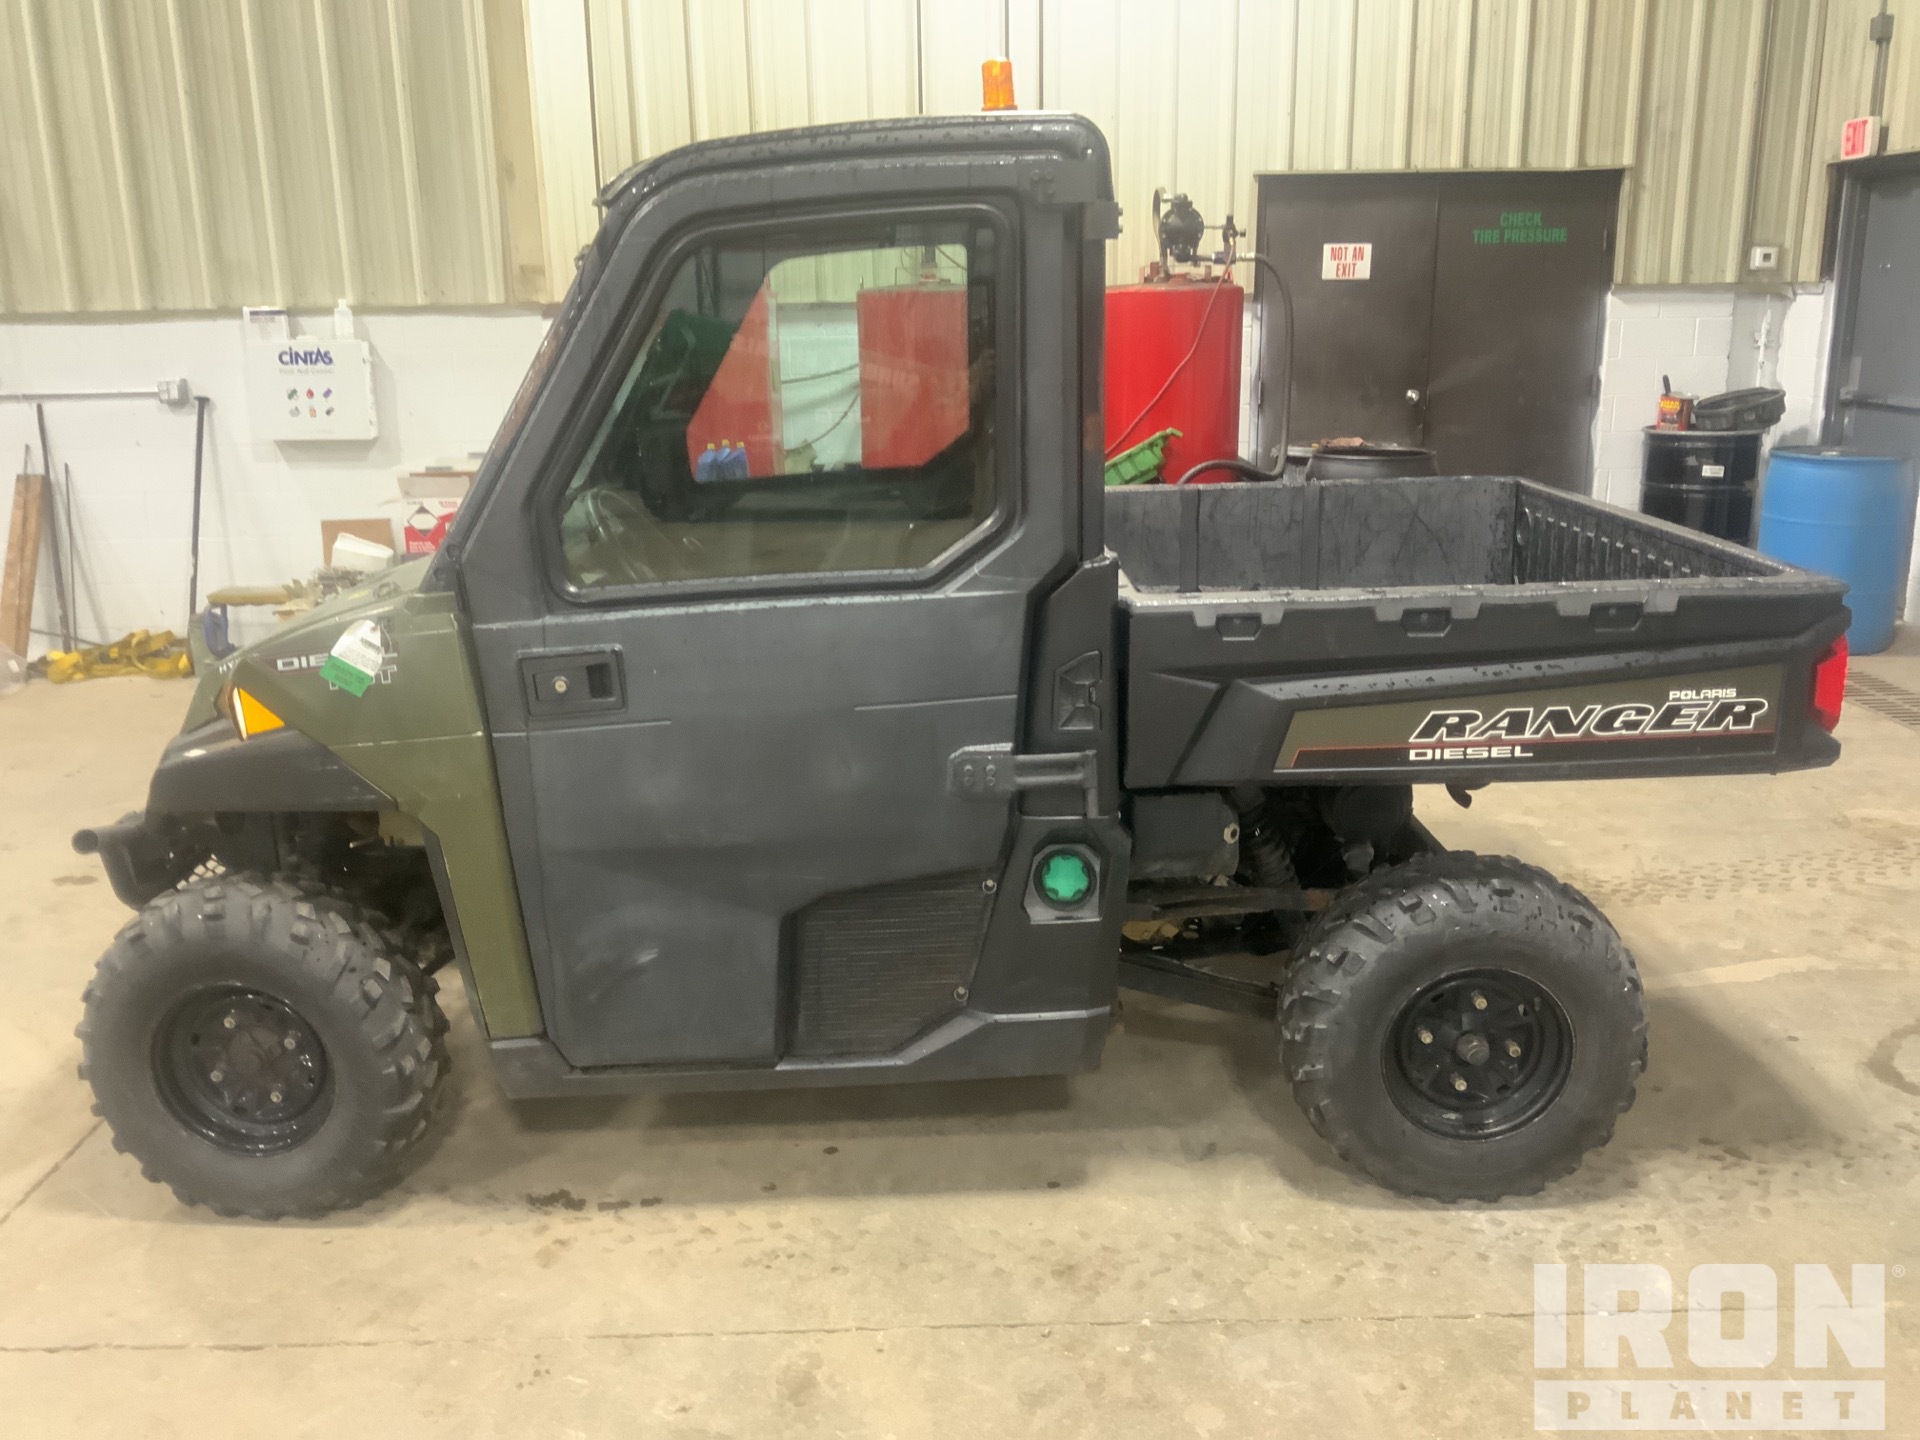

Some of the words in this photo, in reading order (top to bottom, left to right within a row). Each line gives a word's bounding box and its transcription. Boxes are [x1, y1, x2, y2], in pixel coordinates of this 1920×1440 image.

[1844, 119, 1868, 156] EXIT
[1500, 212, 1542, 227] CHECK
[1473, 229, 1500, 244] TIRE
[1504, 227, 1568, 243] PRESSURE
[1330, 246, 1348, 262] NOT
[1352, 246, 1364, 262] AN
[1335, 262, 1357, 278] EXIT
[278, 346, 333, 366] CINTAS
[1669, 688, 1737, 701] POLARIS
[1408, 698, 1769, 743] RANGER
[1409, 745, 1533, 761] DIESEL
